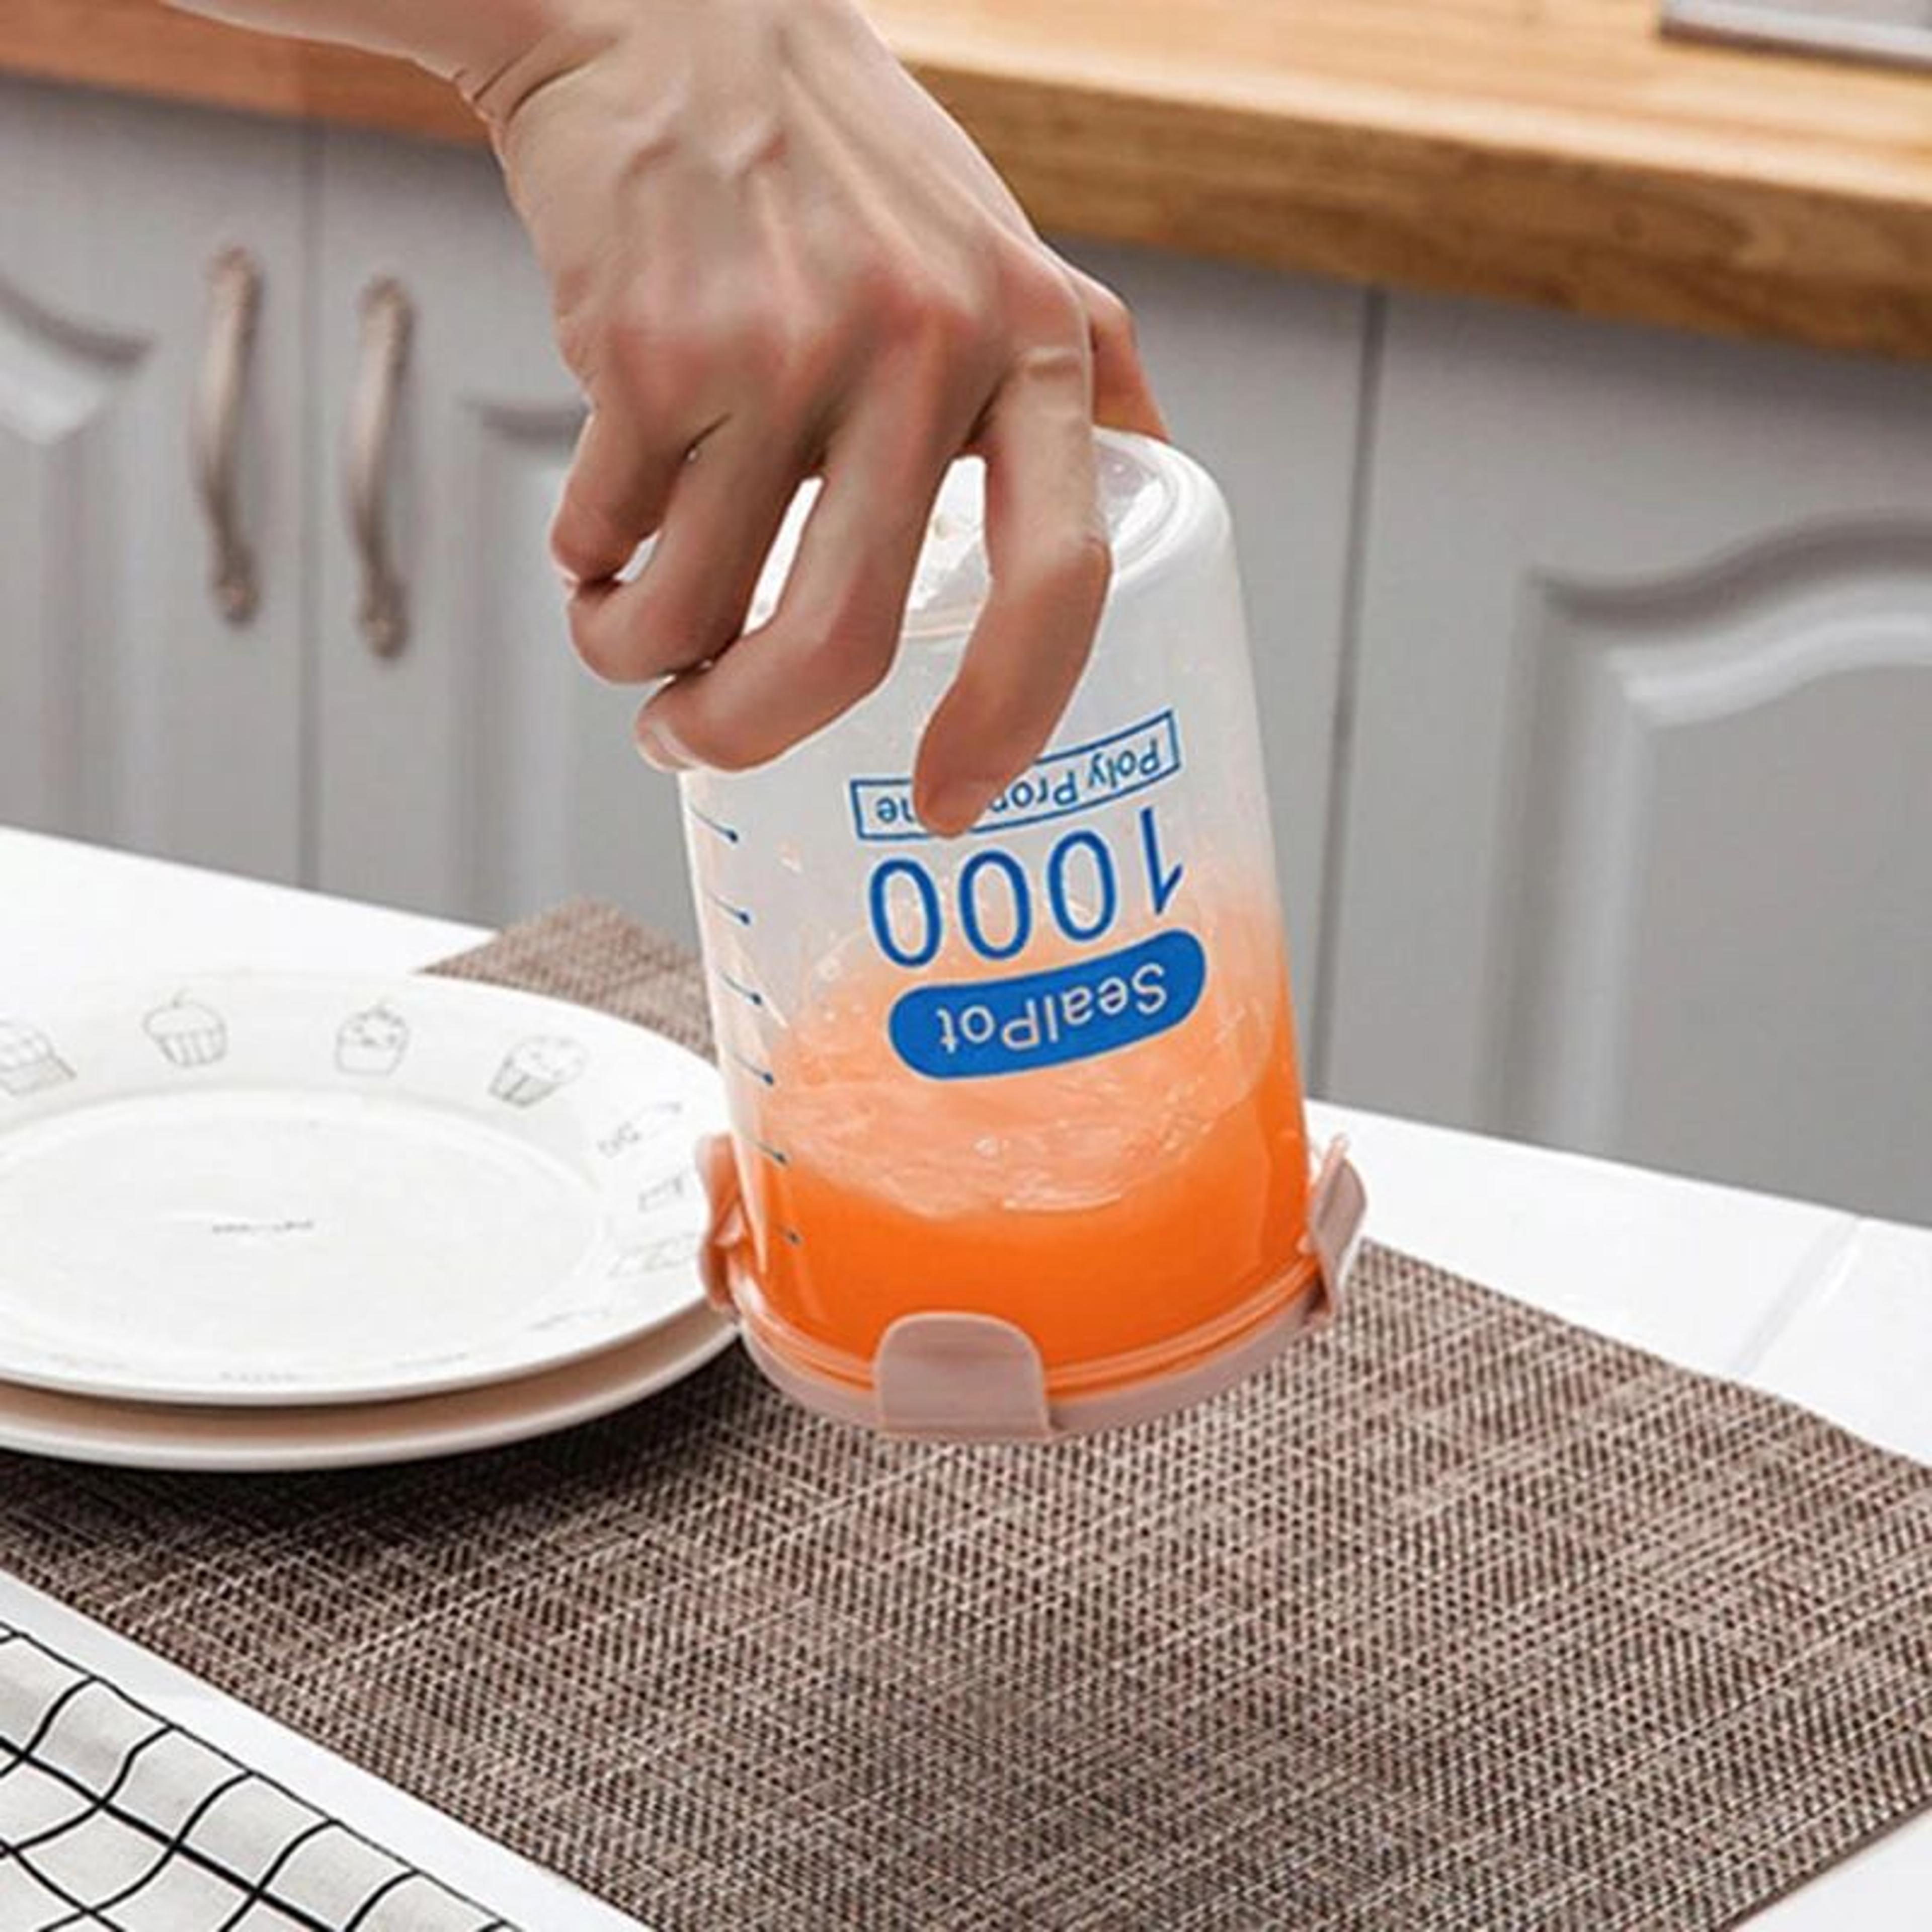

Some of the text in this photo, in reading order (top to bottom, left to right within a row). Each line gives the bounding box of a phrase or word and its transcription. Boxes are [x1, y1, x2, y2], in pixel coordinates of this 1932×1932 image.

[877, 740, 1161, 825] Poly Prone
[869, 806, 1183, 969] 1000
[936, 961, 1168, 1054] SealPot
